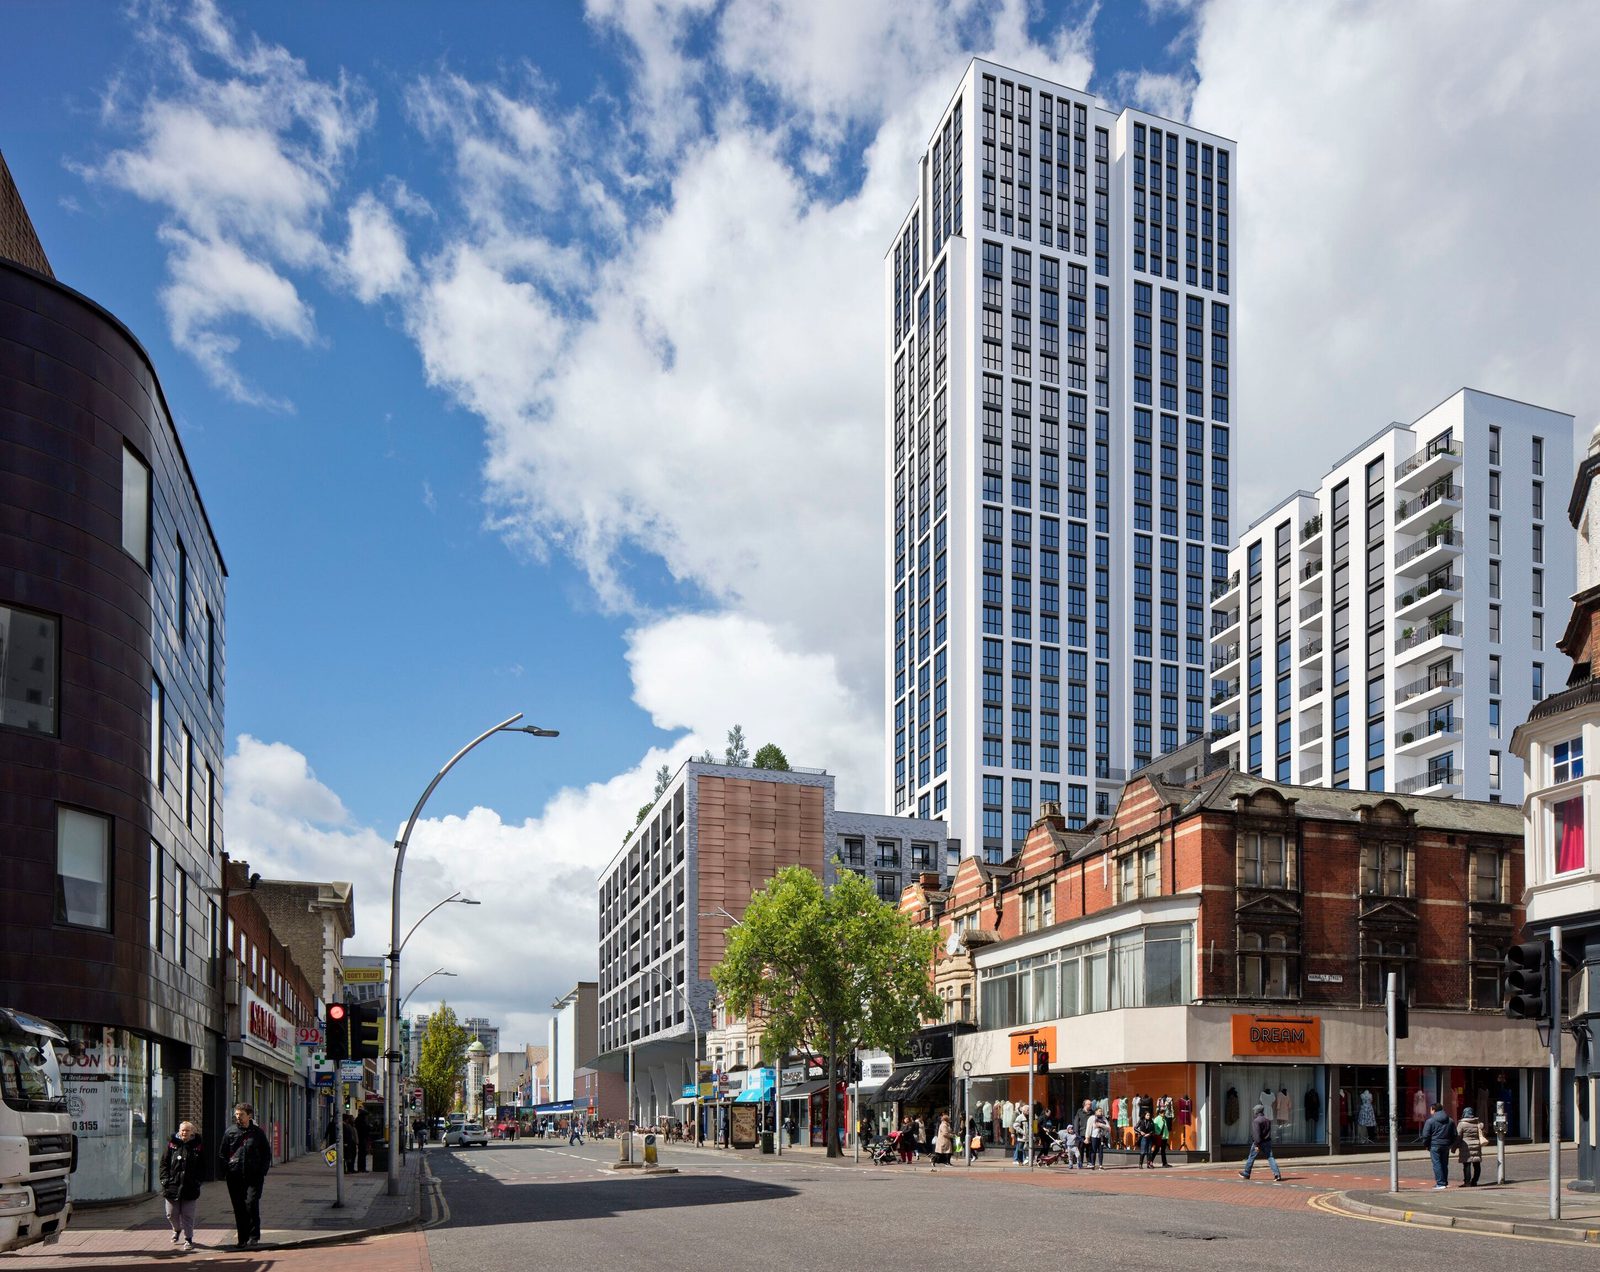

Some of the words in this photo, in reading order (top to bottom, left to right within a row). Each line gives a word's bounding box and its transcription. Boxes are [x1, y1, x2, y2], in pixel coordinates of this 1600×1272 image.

[1250, 1027, 1305, 1043] DREAM
[1018, 1039, 1047, 1055] DRAM
[80, 1086, 98, 1094] from
[80, 1121, 98, 1131] 3155
